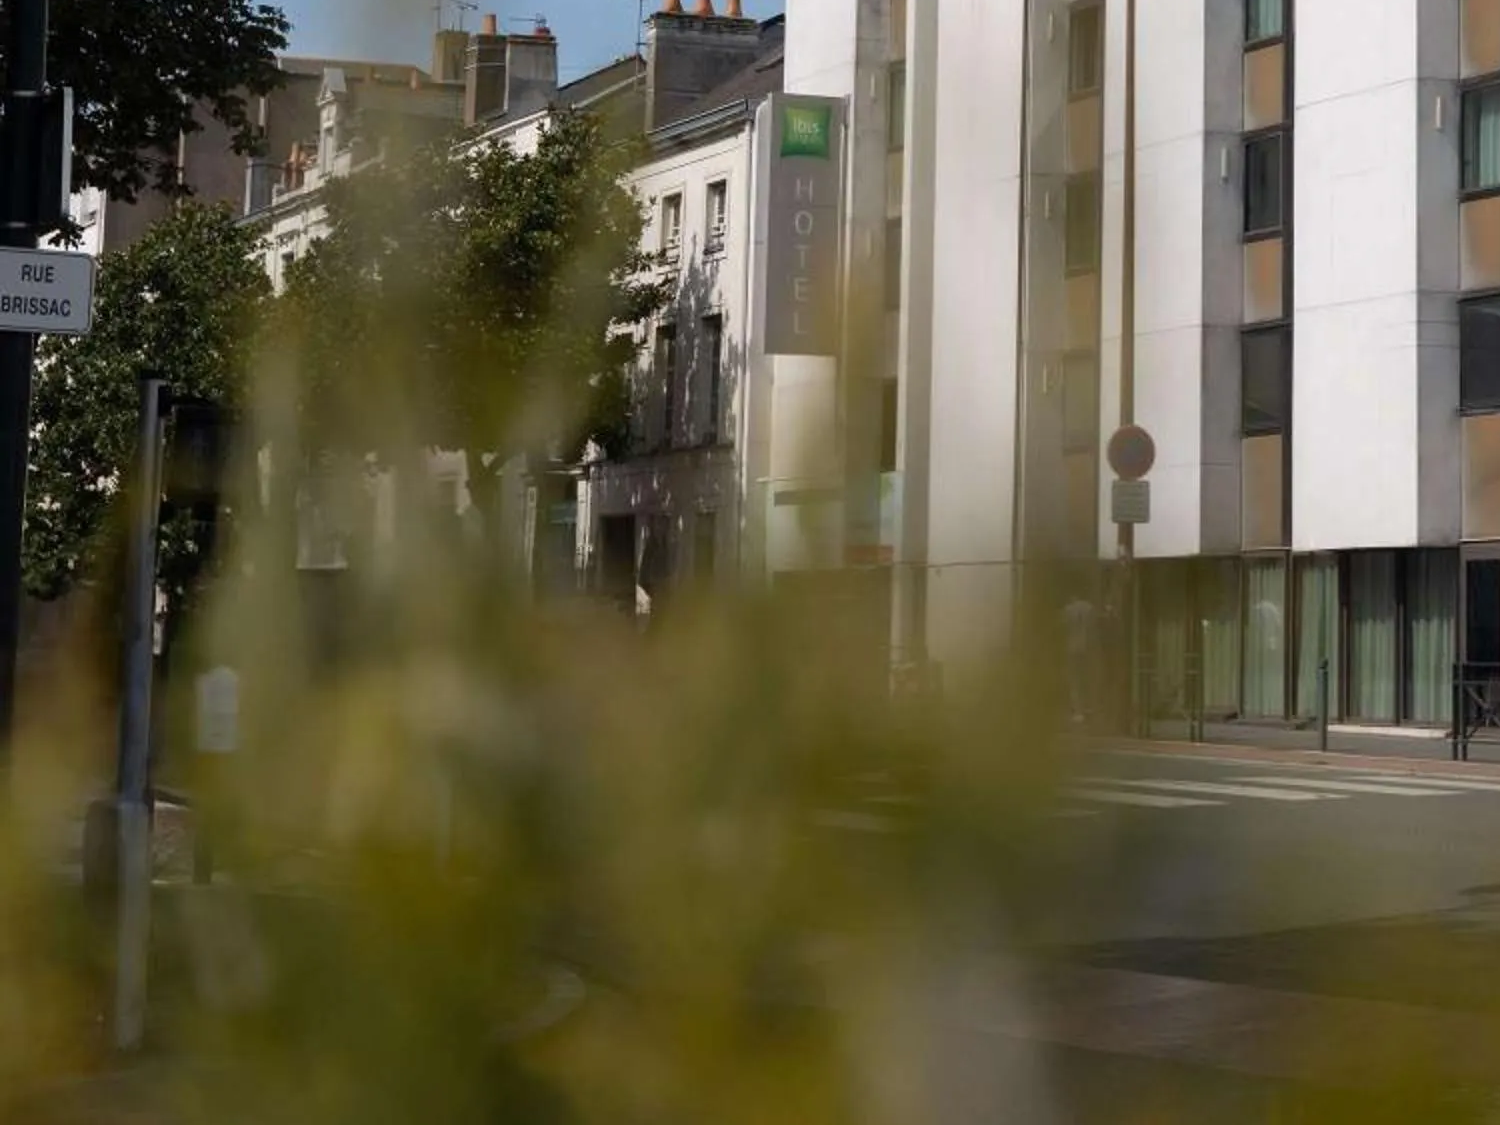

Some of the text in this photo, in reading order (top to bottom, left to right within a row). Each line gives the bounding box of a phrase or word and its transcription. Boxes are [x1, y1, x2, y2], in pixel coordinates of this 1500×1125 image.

[793, 178, 814, 334] HOTEL
[21, 263, 55, 283] RUE
[1, 295, 71, 317] BRISSAC
